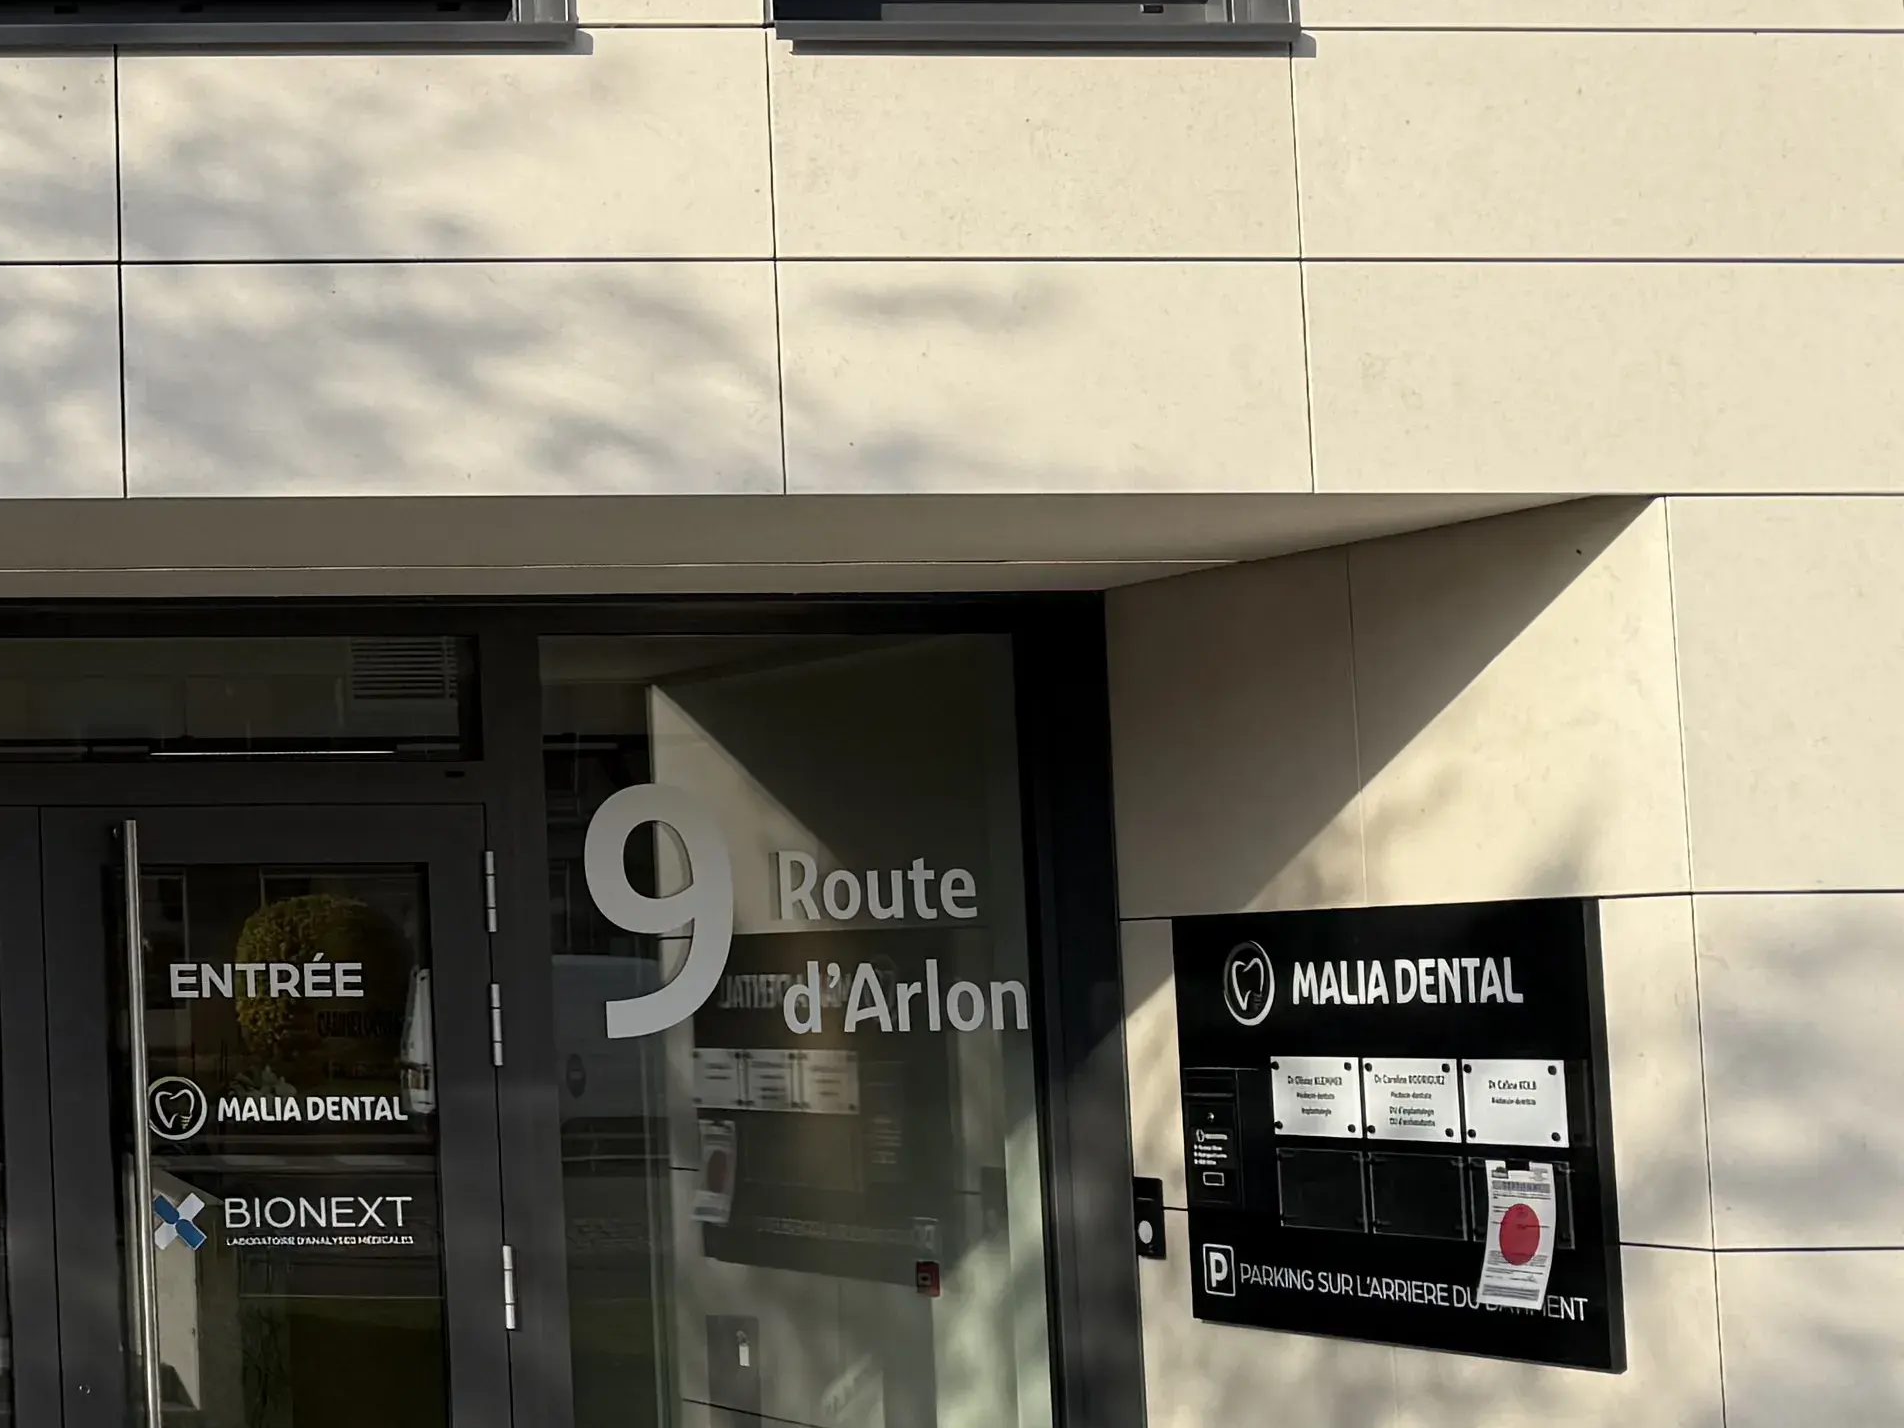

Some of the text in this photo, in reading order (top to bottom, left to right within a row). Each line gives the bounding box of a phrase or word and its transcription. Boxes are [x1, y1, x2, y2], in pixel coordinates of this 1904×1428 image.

[777, 849, 979, 921] Route
[583, 782, 734, 1039] 9
[169, 952, 365, 999] ENTRÉE
[1291, 956, 1525, 1006] MALIA DENTAL
[217, 1096, 409, 1122] MALIA DENTAL
[224, 1196, 413, 1230] BIONEXT
[1239, 1262, 1315, 1292] PARKING
[1317, 1271, 1354, 1296] SUR
[1356, 1274, 1451, 1307] L'ARRIERE
[1452, 1284, 1480, 1310] DU
